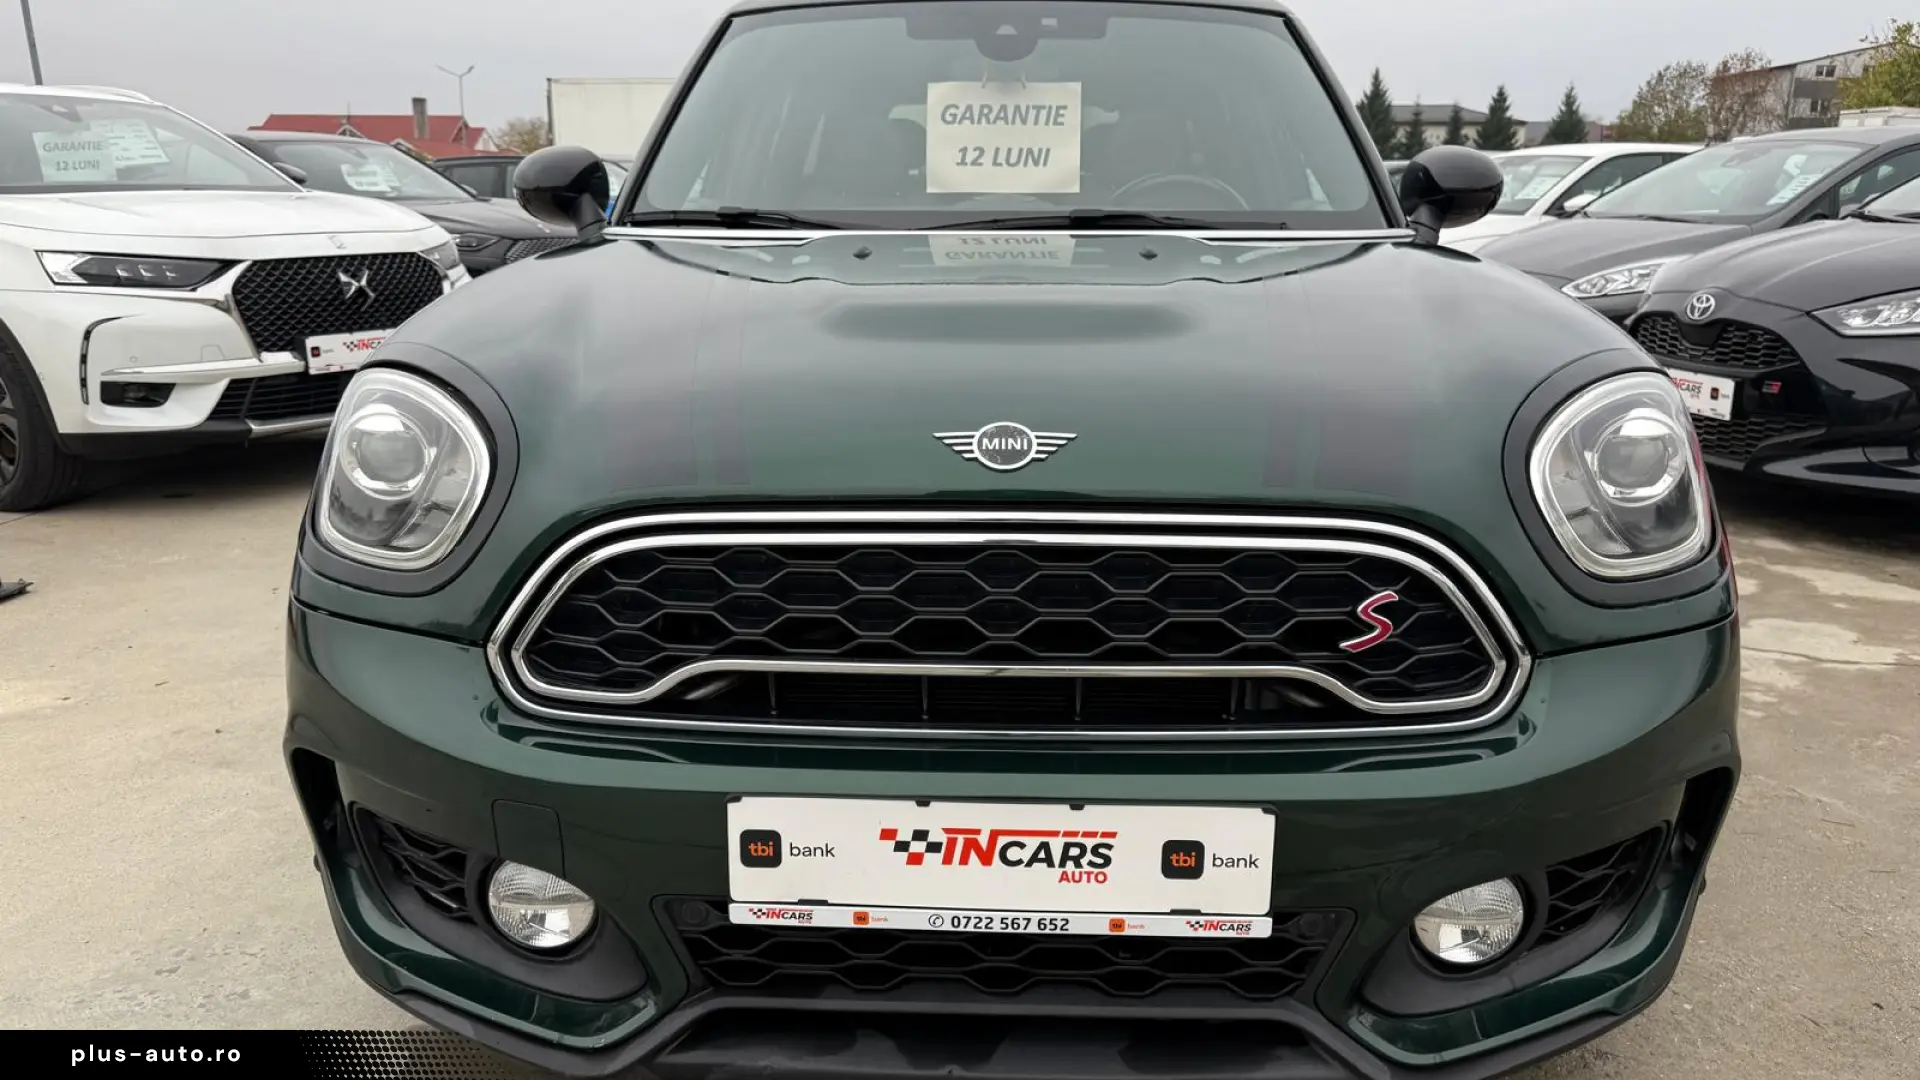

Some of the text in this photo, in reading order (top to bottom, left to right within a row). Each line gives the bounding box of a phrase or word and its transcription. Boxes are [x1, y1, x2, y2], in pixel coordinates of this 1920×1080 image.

[940, 103, 1068, 127] GARANTIE
[42, 140, 104, 153] GARANTIE
[55, 159, 100, 171] 12 LUNI
[955, 146, 1051, 168] 12 LUNI
[982, 437, 1028, 451] MINI
[1339, 590, 1399, 653] S
[748, 841, 836, 858] tbi bank
[941, 827, 1115, 870] INCARS
[1170, 852, 1260, 869] tbi bank
[1058, 870, 1108, 885] AUTO
[765, 907, 813, 920] INCARS
[950, 915, 1069, 932] 0722 567 652
[1202, 919, 1252, 932] INCARS
